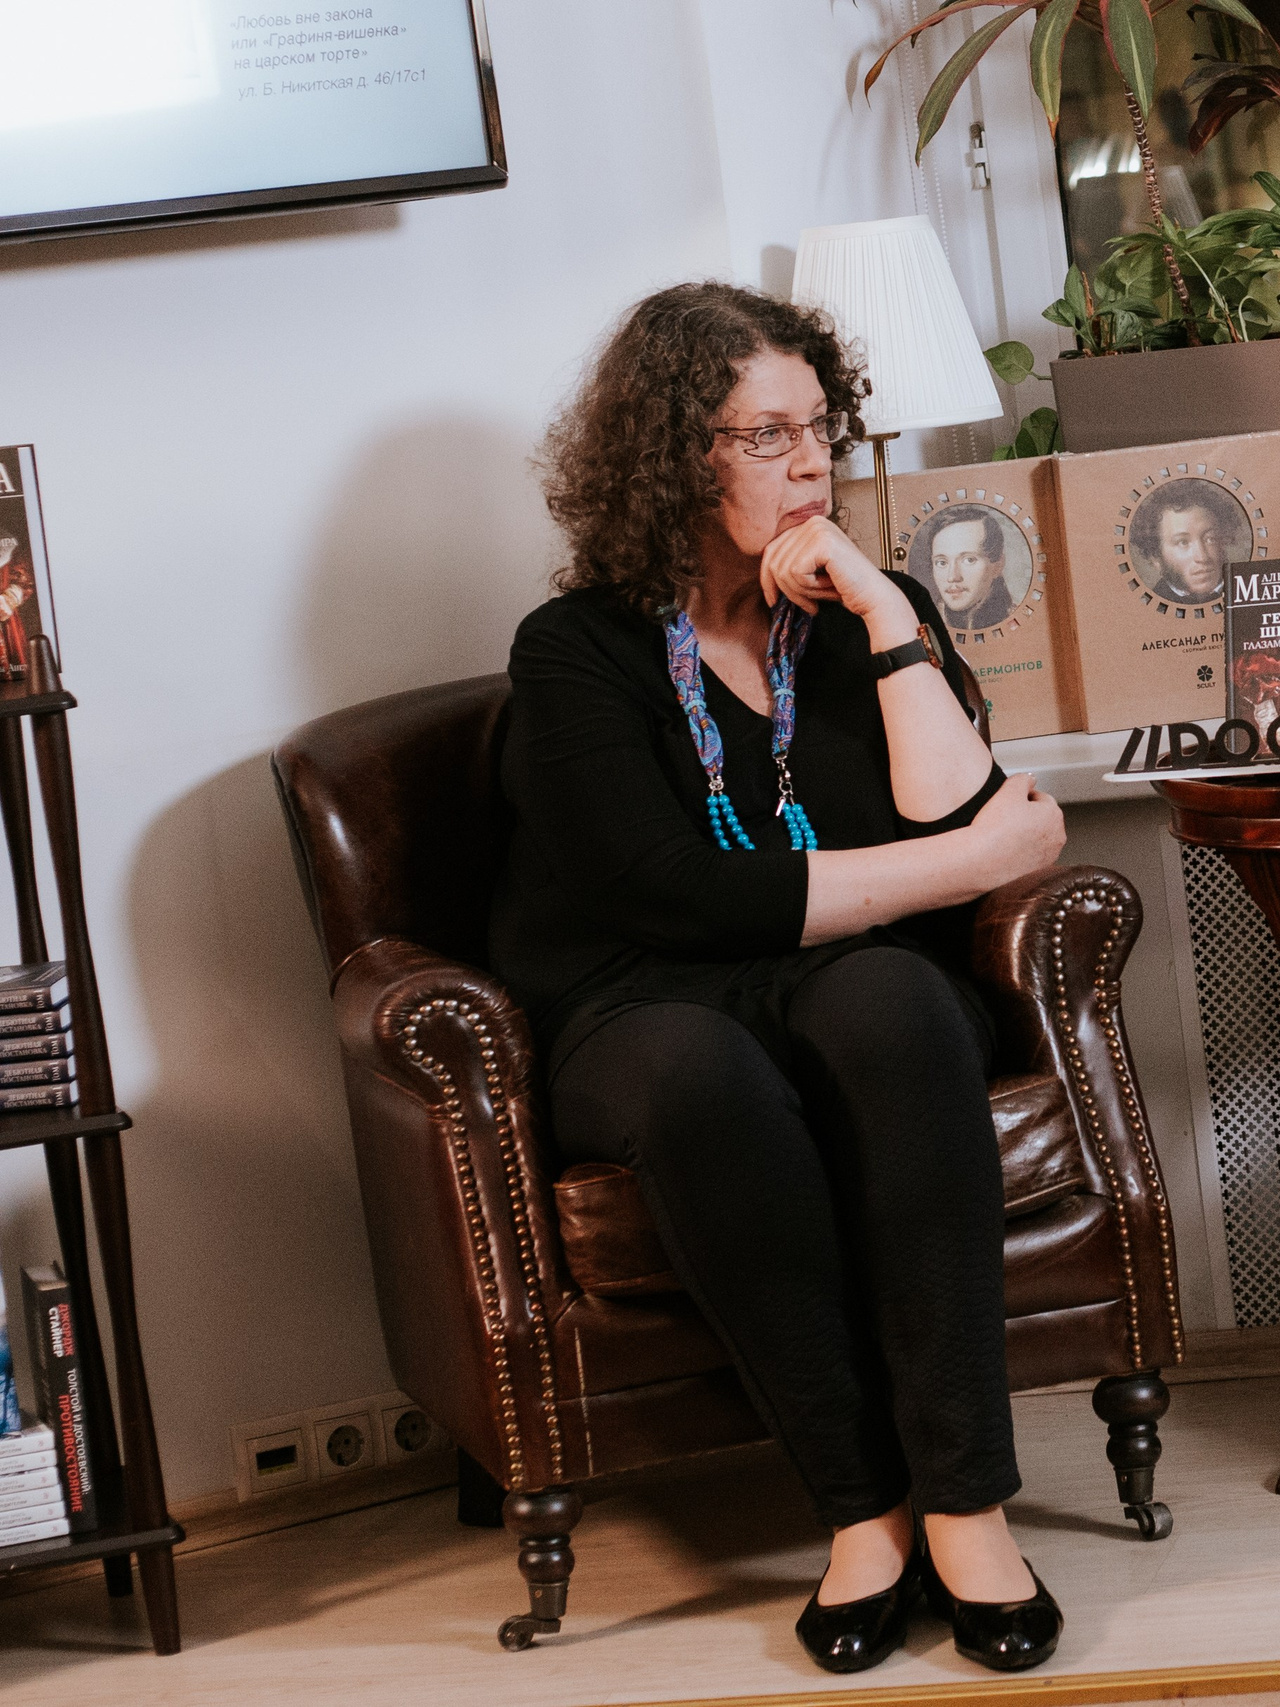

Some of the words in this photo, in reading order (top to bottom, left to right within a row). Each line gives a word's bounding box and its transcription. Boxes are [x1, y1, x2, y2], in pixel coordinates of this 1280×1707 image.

[230, 15, 291, 30] «Любовь
[296, 13, 320, 25] вне
[324, 8, 373, 22] закона
[231, 37, 257, 50] или
[263, 25, 407, 50] «Графиня-вишенка»
[234, 57, 250, 70] на
[255, 52, 315, 70] царском
[321, 47, 368, 64] торте»
[238, 86, 258, 102] ул.
[263, 82, 277, 96] Б.
[282, 75, 353, 95] Никитская
[357, 75, 369, 90] д.
[1141, 634, 1207, 652] АЛЕКСАНДР
[48, 1306, 64, 1358] СТАЙНЕР
[58, 1303, 74, 1357] ДЖОРДЖ
[66, 1368, 82, 1413] ТОЛСТОЙ
[73, 1414, 82, 1423] И
[58, 1394, 83, 1513] ПРОТИВОСТОЯНИЕ
[73, 1423, 92, 1497] ДОСТОЕВСКИЙ:
